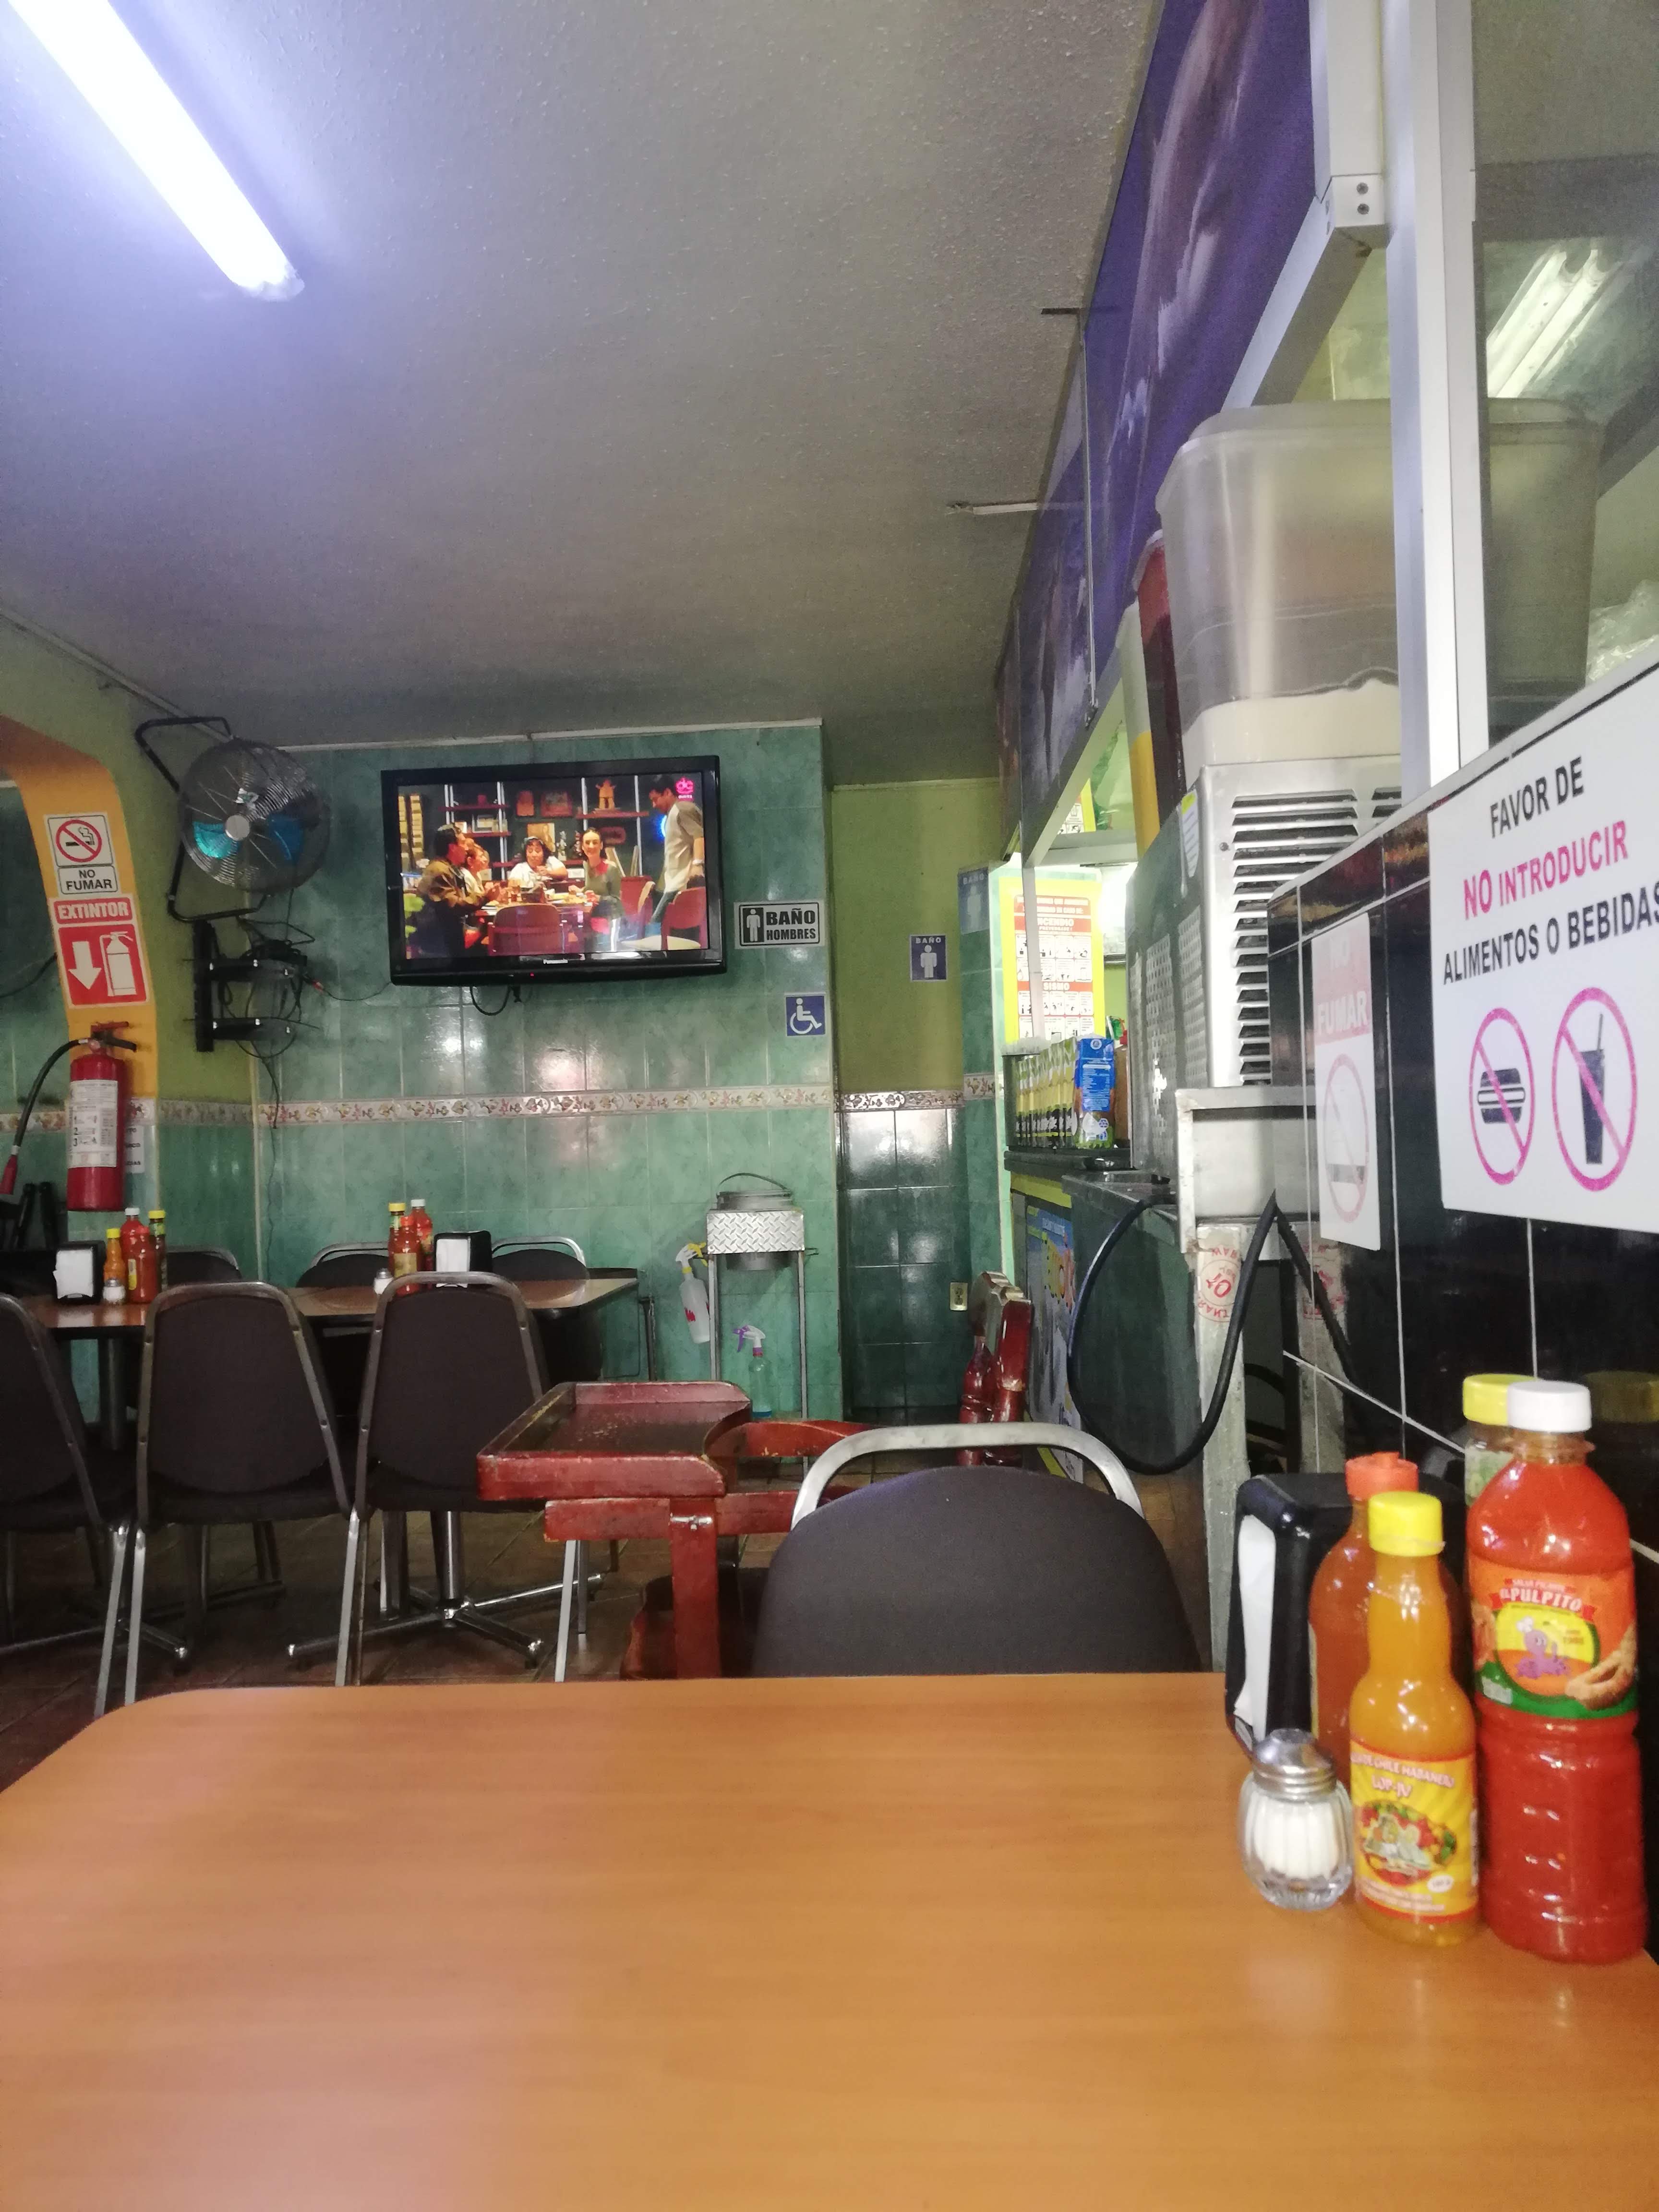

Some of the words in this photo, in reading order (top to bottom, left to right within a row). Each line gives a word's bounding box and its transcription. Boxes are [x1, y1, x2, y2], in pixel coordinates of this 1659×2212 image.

[1490, 776, 1550, 838] FAVOR
[1556, 756, 1584, 805] DE
[79, 869, 96, 878] NO
[1464, 869, 1492, 920] NO
[1499, 820, 1628, 907] INTRODUCIR
[66, 879, 112, 890] FUMAR
[57, 902, 129, 920] EXTINTOR
[766, 908, 816, 926] BAÑO
[767, 928, 816, 940] HOMBRES
[1443, 924, 1538, 985] ALIMENTOS
[1546, 917, 1560, 954] O
[1043, 982, 1070, 991] SISMO
[1317, 990, 1368, 1034] FUMAR
[1511, 1587, 1583, 1612] PULPITO
